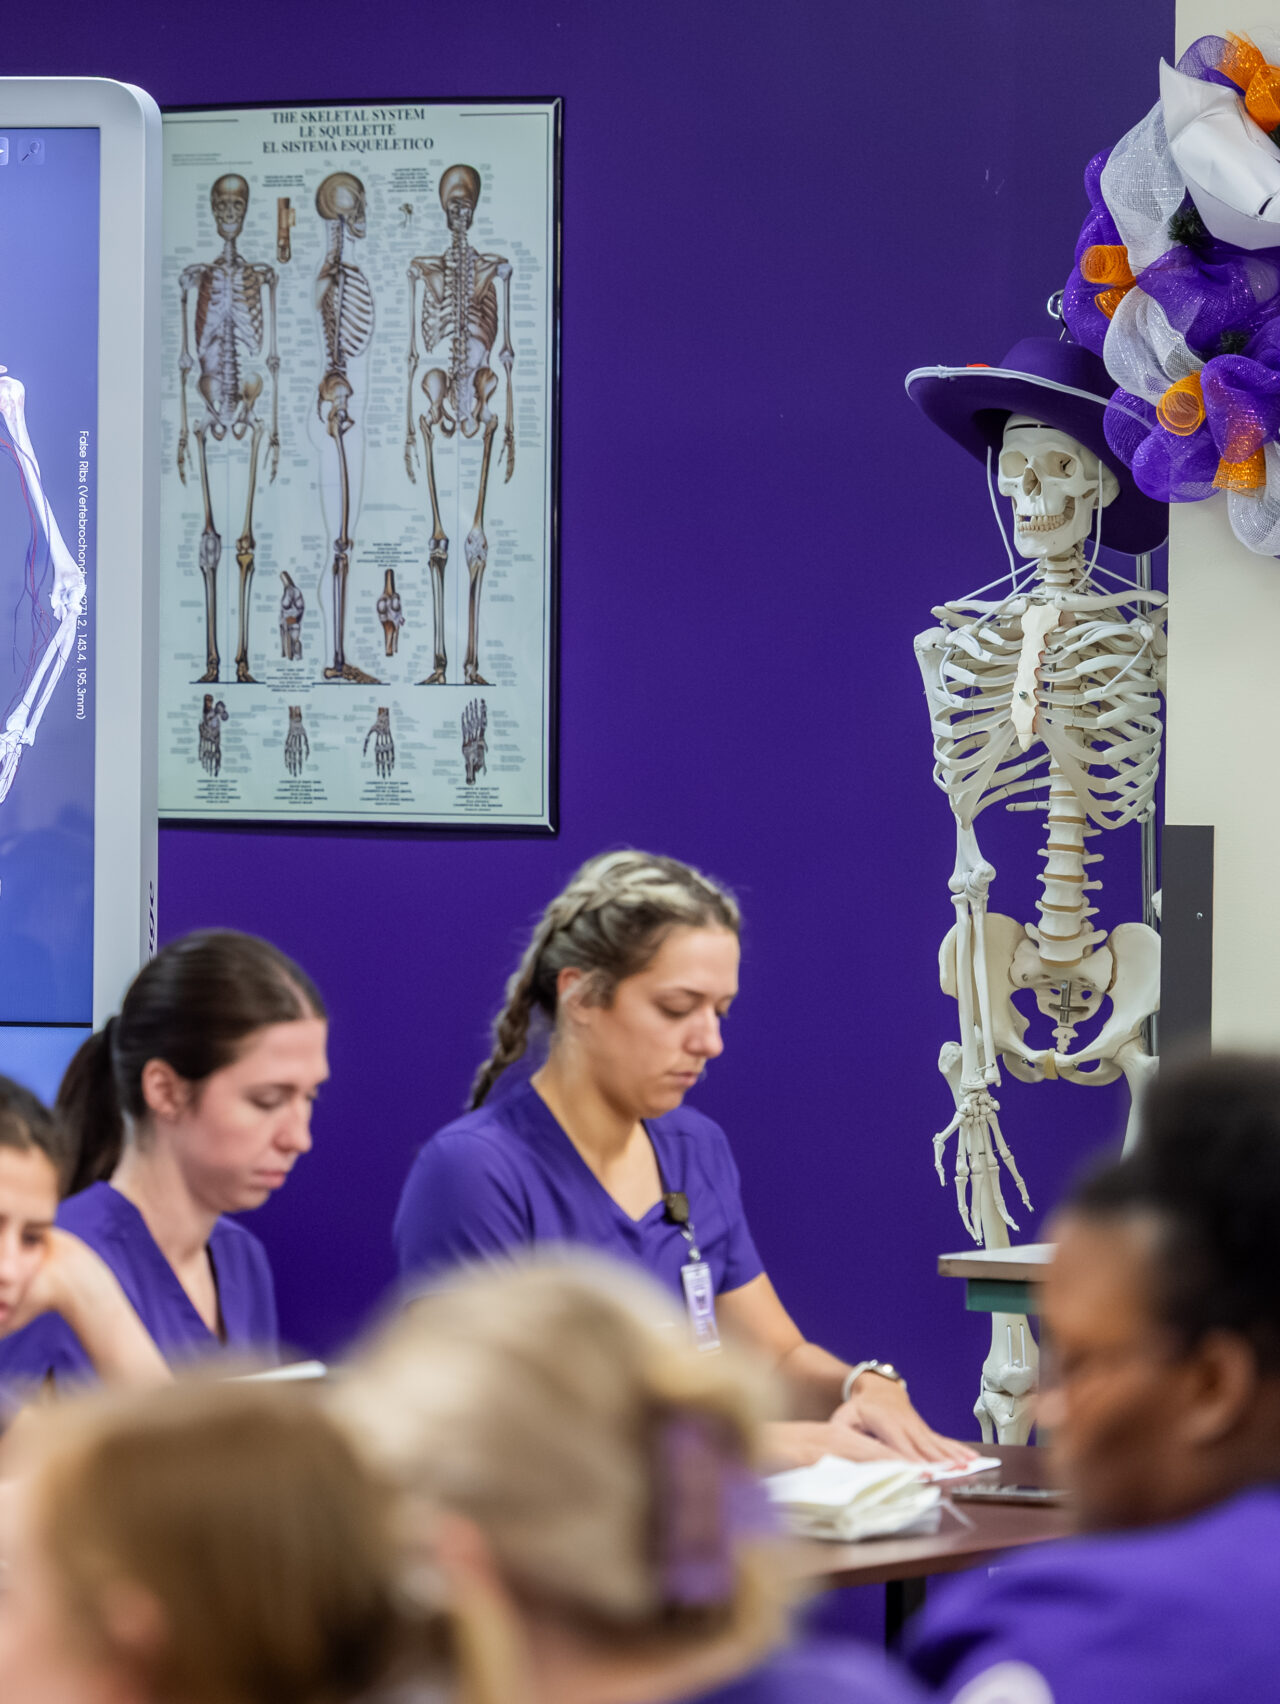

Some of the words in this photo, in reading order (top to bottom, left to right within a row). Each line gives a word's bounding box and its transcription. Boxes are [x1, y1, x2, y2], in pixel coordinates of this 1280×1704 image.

[272, 111, 297, 124] THE
[301, 109, 370, 123] SKELETAL
[372, 108, 425, 121] SYSTEM
[299, 125, 316, 138] LE
[320, 123, 396, 139] SQUELETTE
[262, 141, 279, 154] EL
[281, 139, 337, 153] SISTEMA
[341, 137, 434, 153] ESQUELETICO
[79, 430, 90, 458] False
[78, 461, 89, 483] Ribs
[76, 634, 88, 663] 143.4,
[75, 668, 88, 720] 195.3mm)
